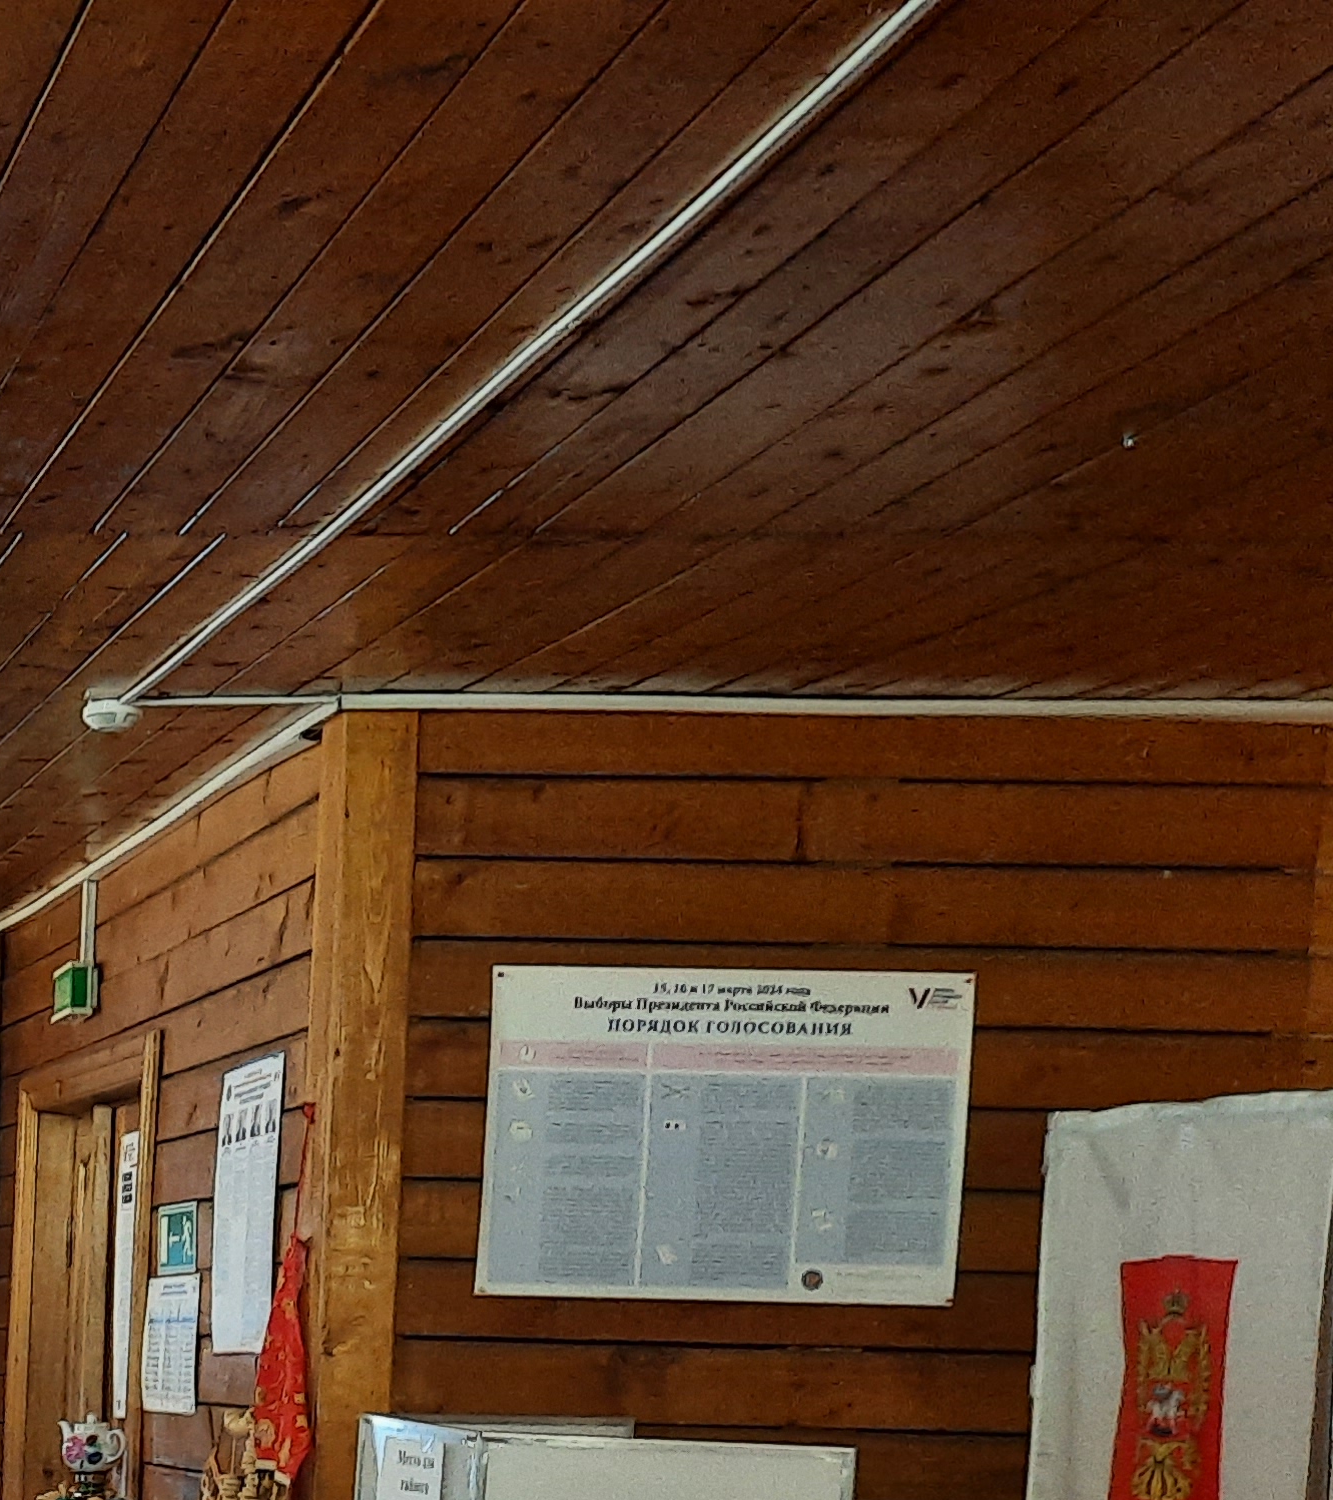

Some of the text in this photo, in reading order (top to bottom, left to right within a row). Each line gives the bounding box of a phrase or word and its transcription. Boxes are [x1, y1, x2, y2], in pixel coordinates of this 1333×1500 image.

[574, 997, 890, 1016] Выборы Президента Российской Федерации
[607, 1017, 852, 1035] ПОРЯДОК ГОЛОСОВАНИЯ
